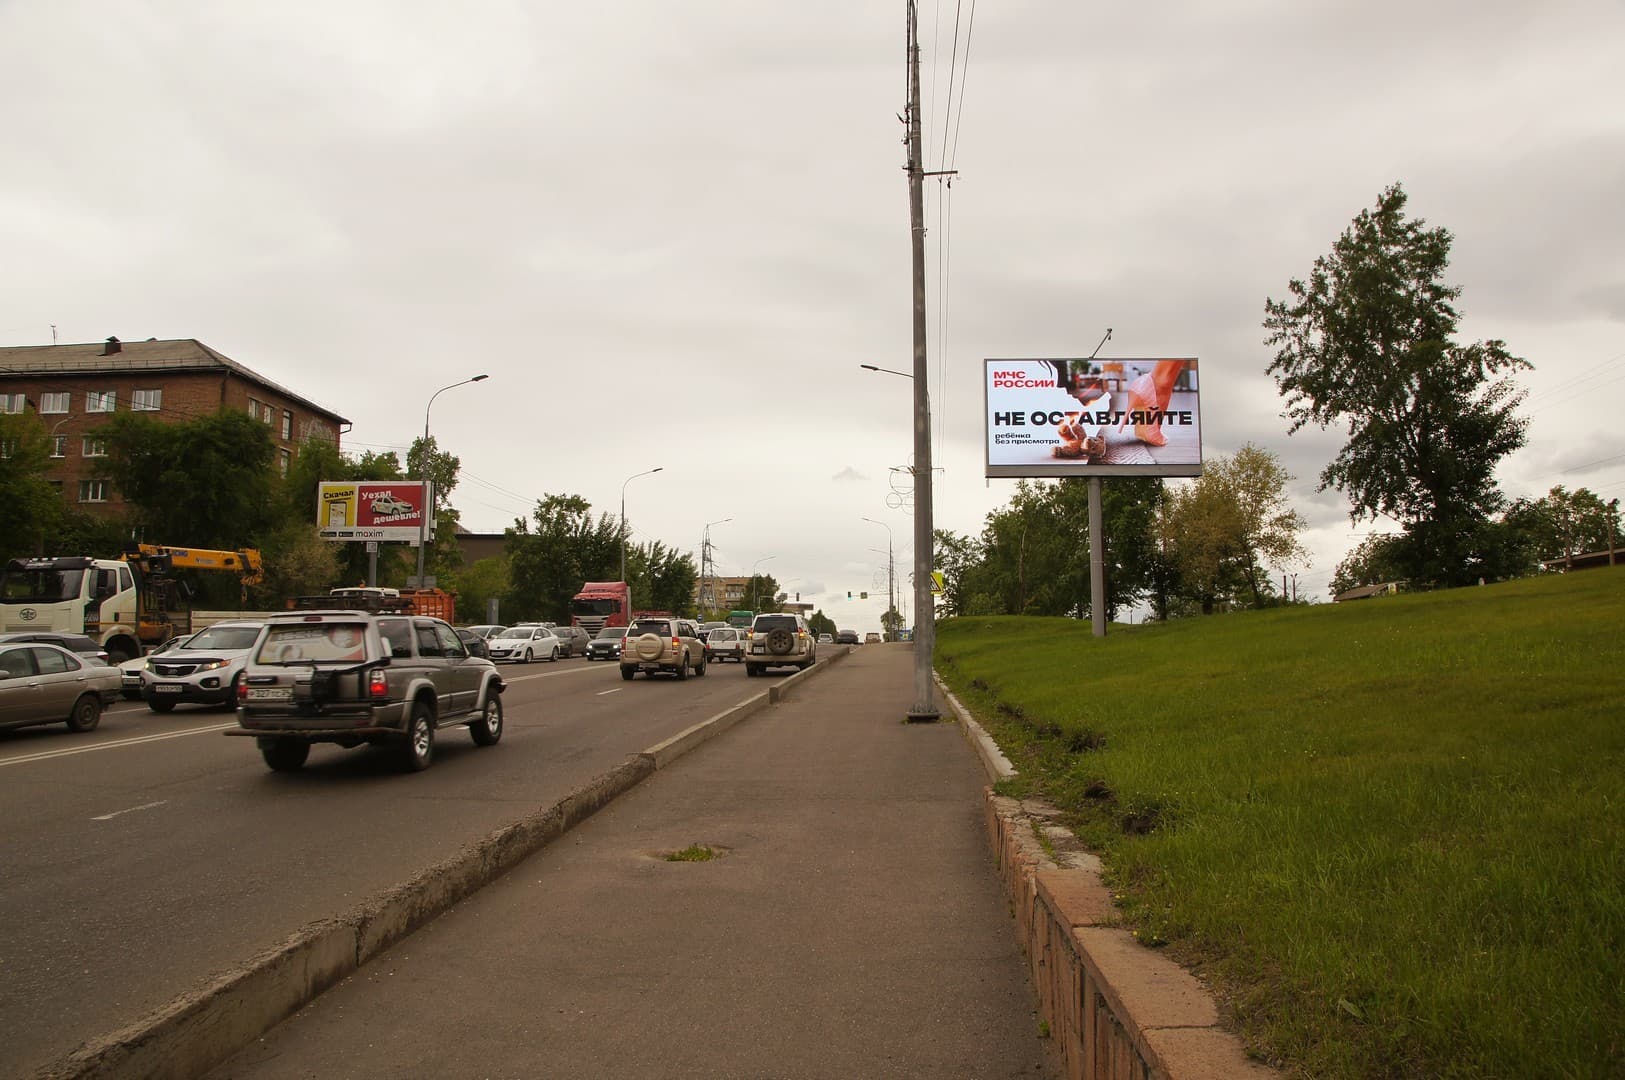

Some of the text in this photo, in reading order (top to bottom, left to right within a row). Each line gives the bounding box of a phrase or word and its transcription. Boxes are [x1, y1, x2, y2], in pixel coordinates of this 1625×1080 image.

[994, 371, 1026, 379] МЧС
[994, 379, 1055, 388] РОССИИ
[994, 406, 1193, 426] НЕ ОСТАВЛЯЙТЕ
[995, 432, 1031, 440] ребёнка
[323, 490, 354, 499] Скачал
[362, 490, 392, 500] Уехал
[355, 530, 384, 538] maxim
